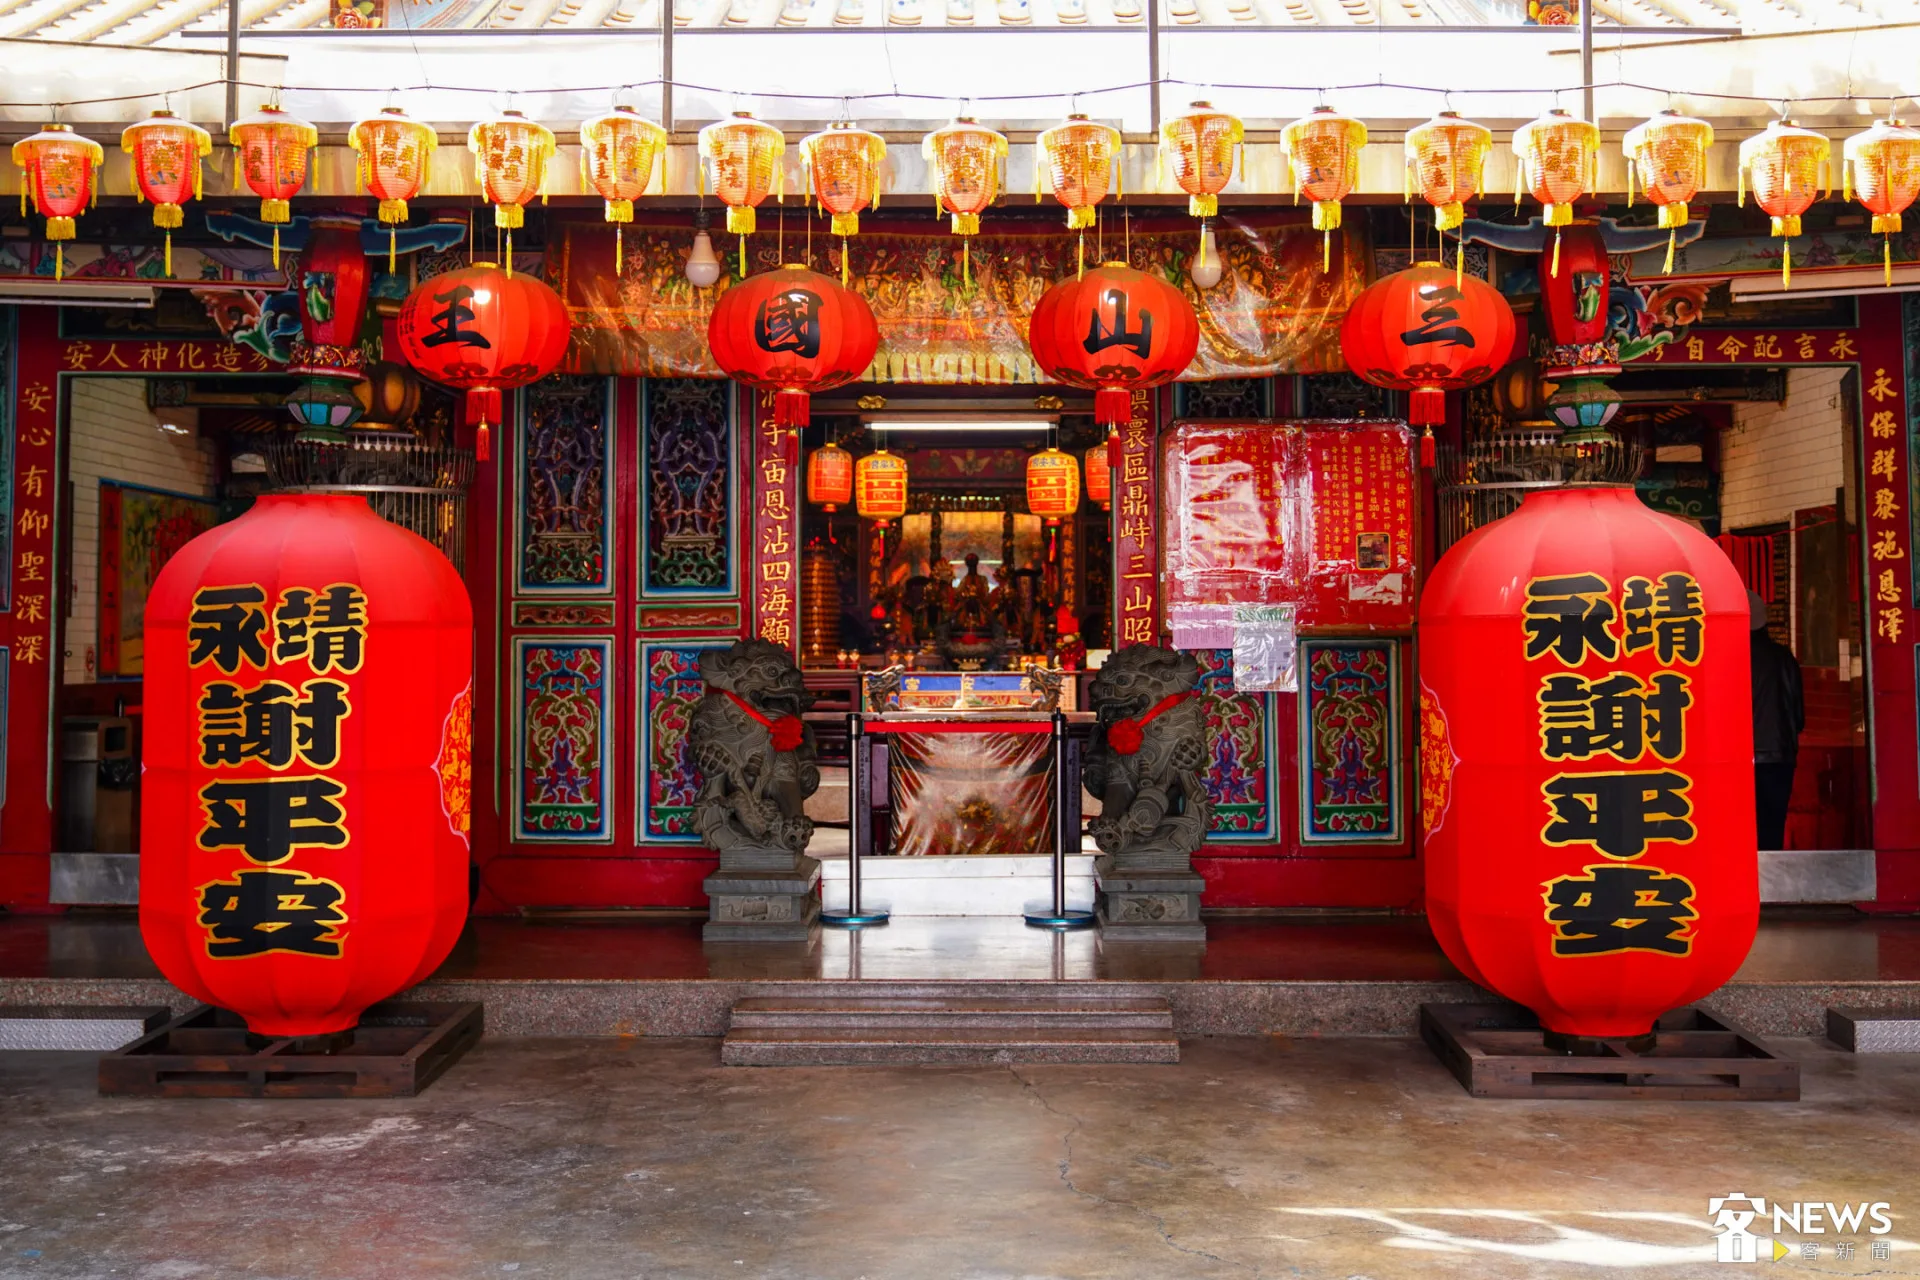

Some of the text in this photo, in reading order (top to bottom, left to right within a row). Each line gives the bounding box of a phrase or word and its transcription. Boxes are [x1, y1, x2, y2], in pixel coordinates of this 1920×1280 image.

[421, 285, 491, 350] 王
[755, 288, 824, 359] 國
[1083, 288, 1154, 360] 山
[1400, 285, 1475, 348] 三
[14, 381, 52, 665] 安心有仰聖深深
[187, 582, 368, 676] 永靖
[1521, 572, 1706, 668] 永靖
[195, 677, 352, 960] 謝平安
[1535, 670, 1700, 958] 謝平安
